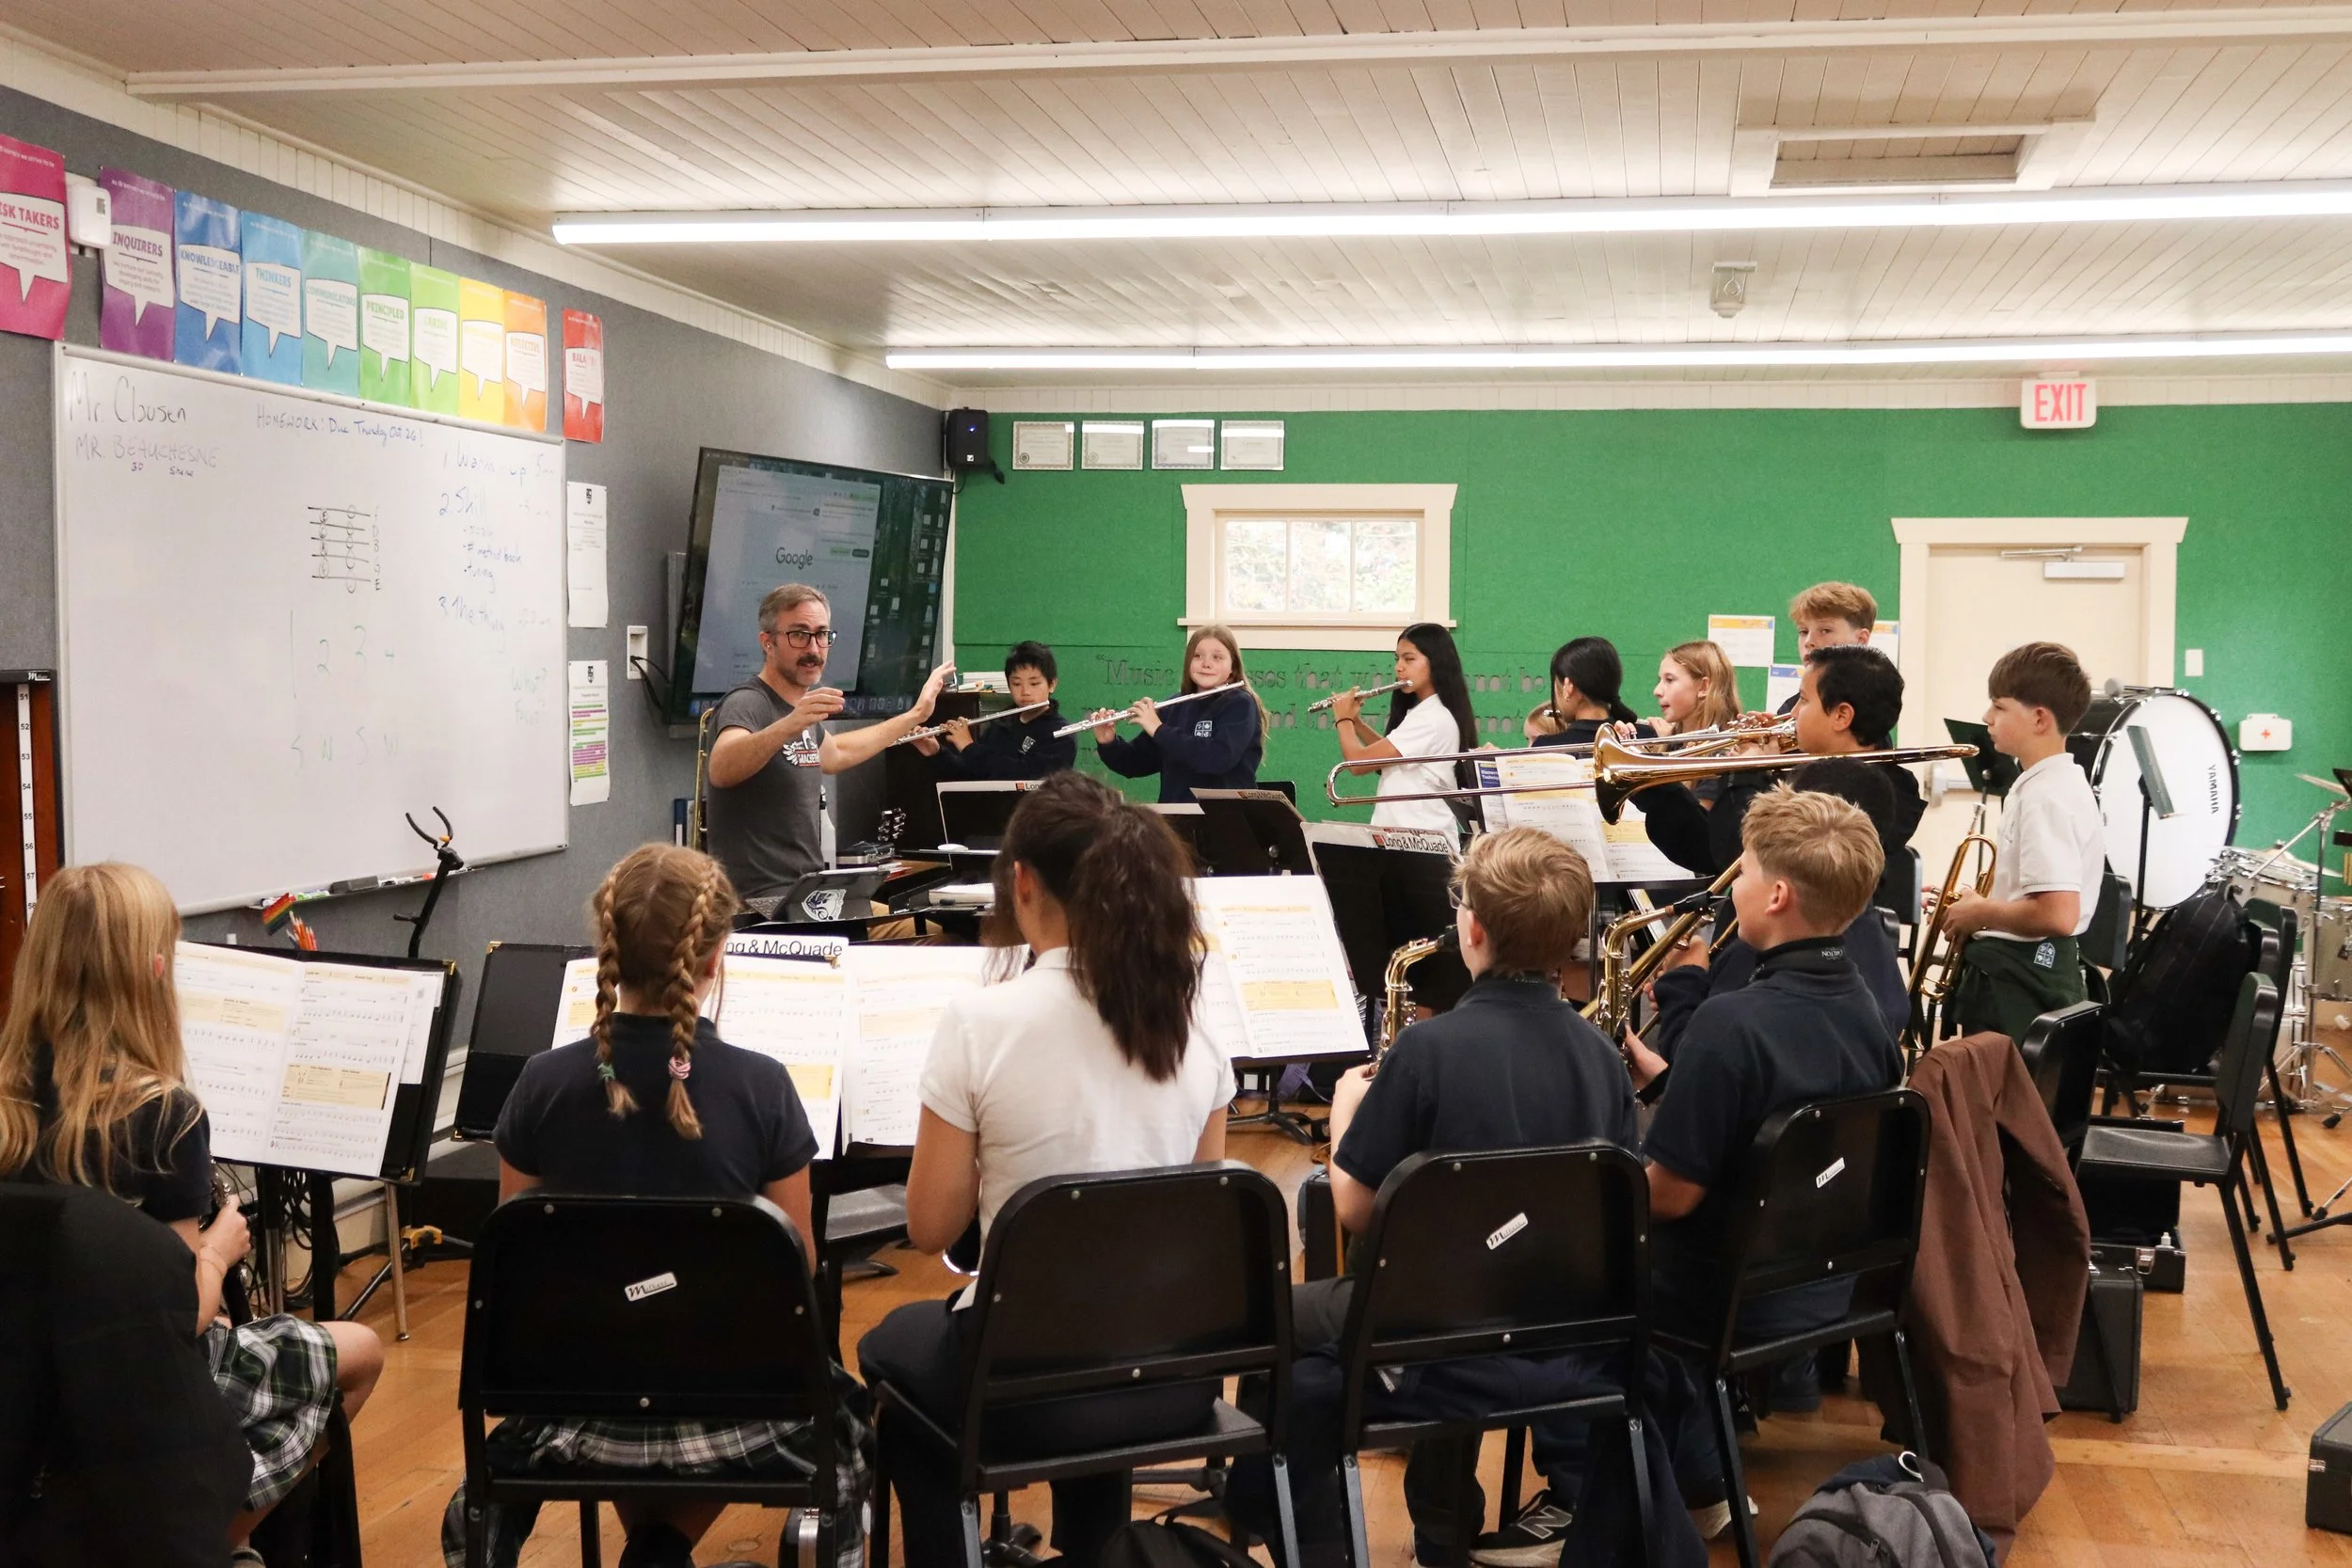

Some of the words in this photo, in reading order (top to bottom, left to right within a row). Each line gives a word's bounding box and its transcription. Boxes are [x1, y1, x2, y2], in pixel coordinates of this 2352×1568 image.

[21, 208, 59, 230] TAKERS
[113, 232, 163, 257] INQUIRERS
[181, 249, 240, 275] KNOWLEEABLE
[256, 267, 292, 287] THINKERS
[308, 286, 357, 307] COMMUNICATORS
[366, 300, 405, 321] PRINCIPLED
[70, 372, 103, 422] Mr.
[2035, 384, 2087, 421] EXIT
[329, 418, 349, 434] Due
[76, 433, 105, 460] MR.
[113, 435, 220, 468] BEAUCHESNE
[776, 546, 813, 570] Google
[317, 639, 330, 675] 2
[354, 625, 367, 679] 3
[1295, 663, 1343, 689] that
[1350, 664, 1394, 689] whi
[1518, 666, 1546, 693] be
[1269, 705, 1296, 729] nd
[2208, 764, 2219, 815] YAMAHA
[1383, 835, 1404, 851] Long
[1408, 837, 1449, 853] McQuade
[724, 942, 745, 953] ng
[749, 939, 758, 953] &
[763, 940, 843, 957] McQuade
